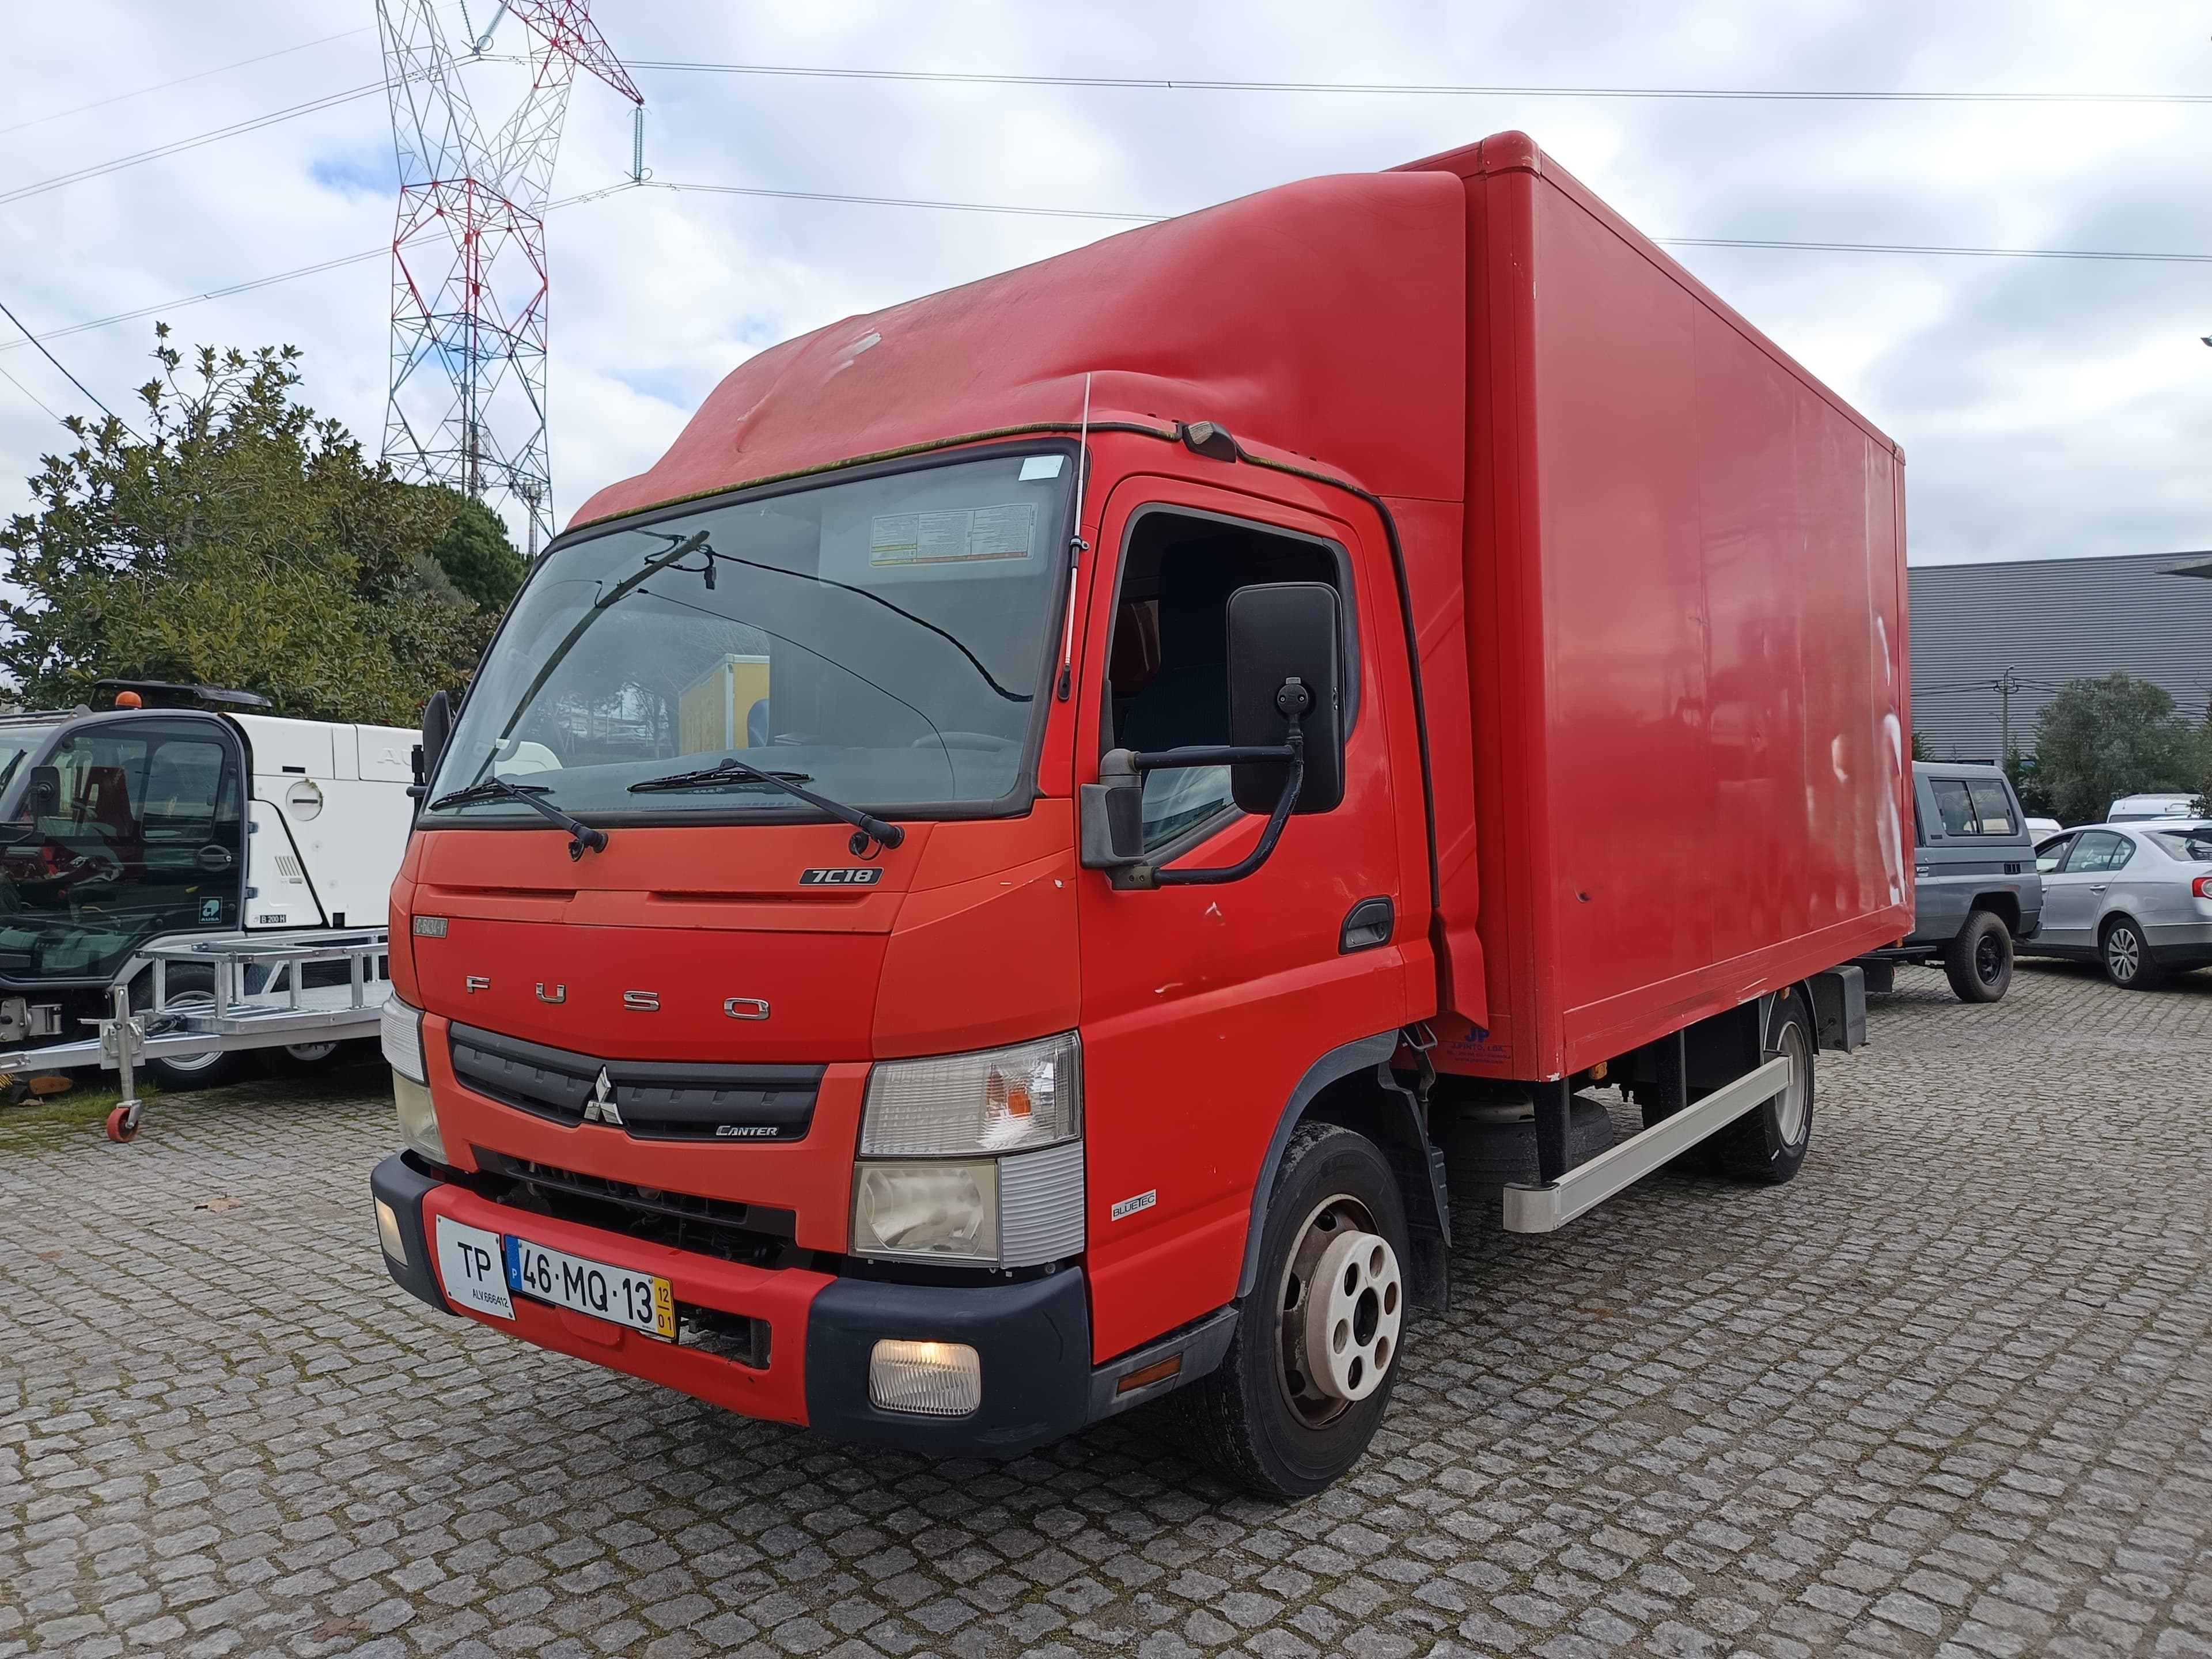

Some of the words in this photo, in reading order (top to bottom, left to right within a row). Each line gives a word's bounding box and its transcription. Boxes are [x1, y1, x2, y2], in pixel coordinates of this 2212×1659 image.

[812, 869, 873, 882] 7C18
[467, 975, 770, 1020] FUSO
[715, 1125, 778, 1136] CANTER
[1113, 1192, 1155, 1217] BLUETEC
[457, 1241, 491, 1282] TP
[512, 1268, 518, 1279] P
[658, 1286, 670, 1303] 12
